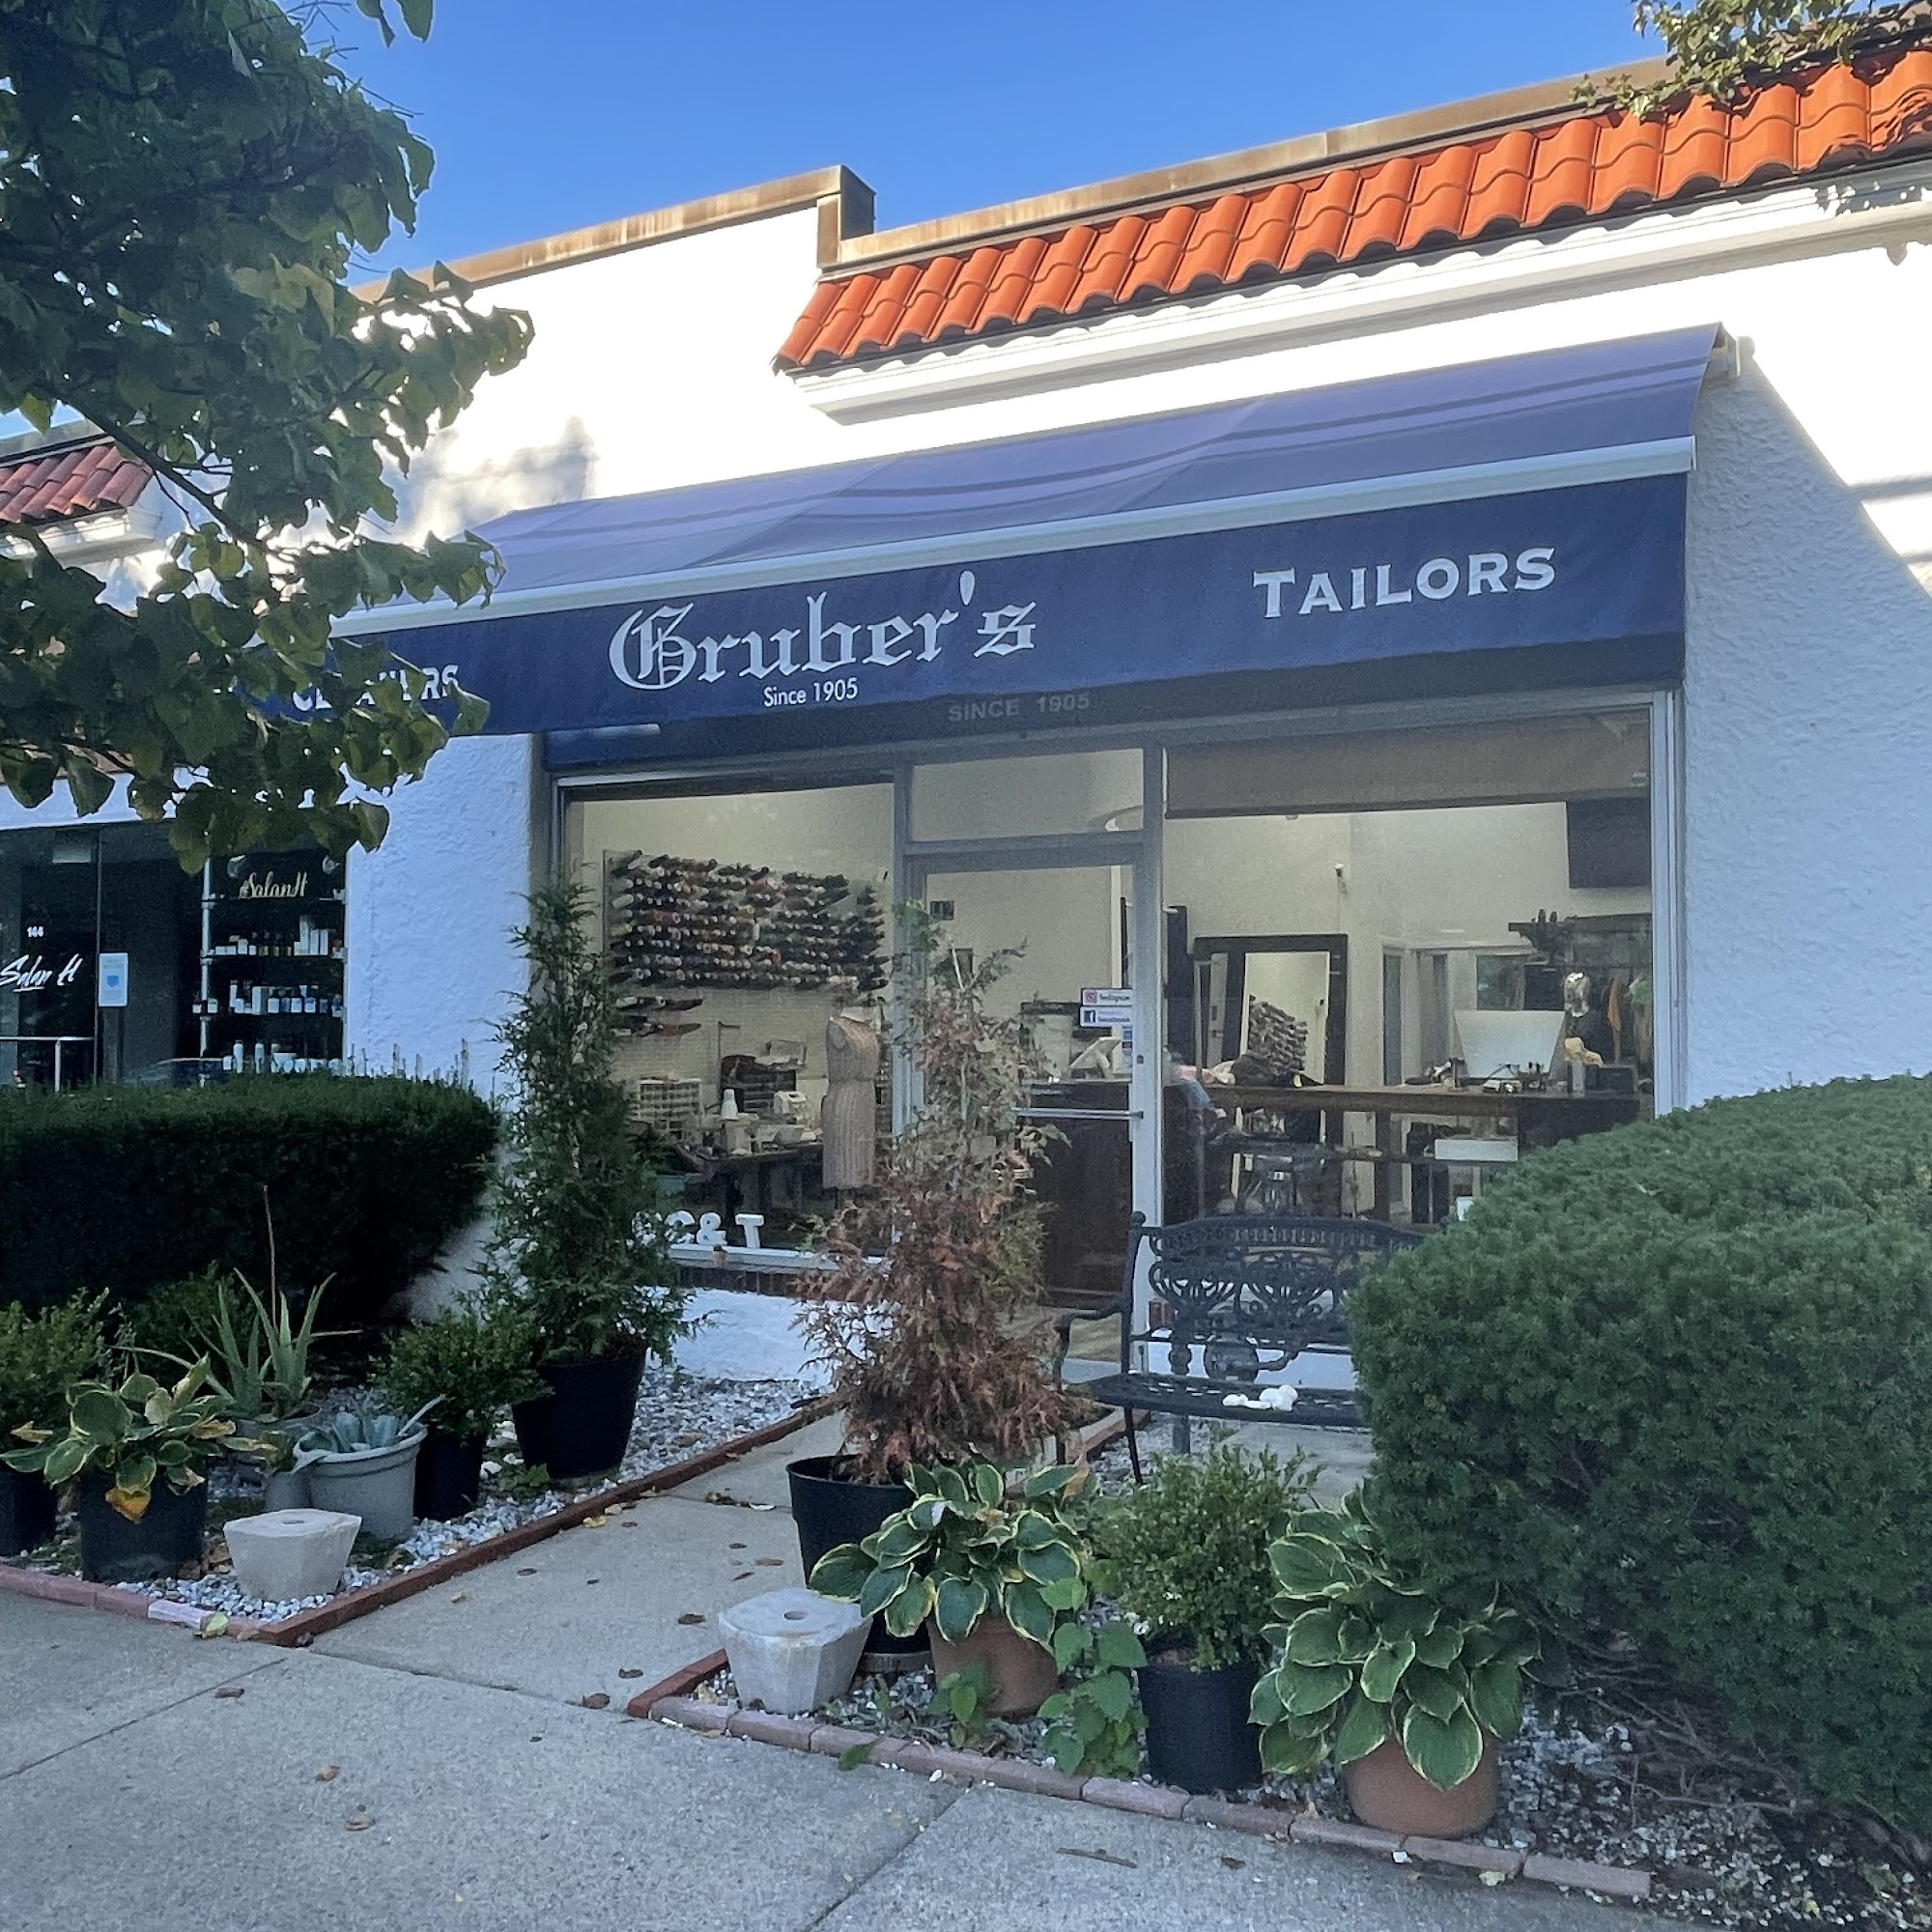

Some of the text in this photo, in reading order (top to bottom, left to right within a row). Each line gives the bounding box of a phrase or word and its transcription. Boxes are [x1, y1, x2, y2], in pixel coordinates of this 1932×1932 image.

[1253, 547, 1555, 618] TAILORS
[609, 570, 1037, 690] Gruber's
[763, 677, 858, 707] Since 1905
[948, 687, 1090, 722] SINCE 1905
